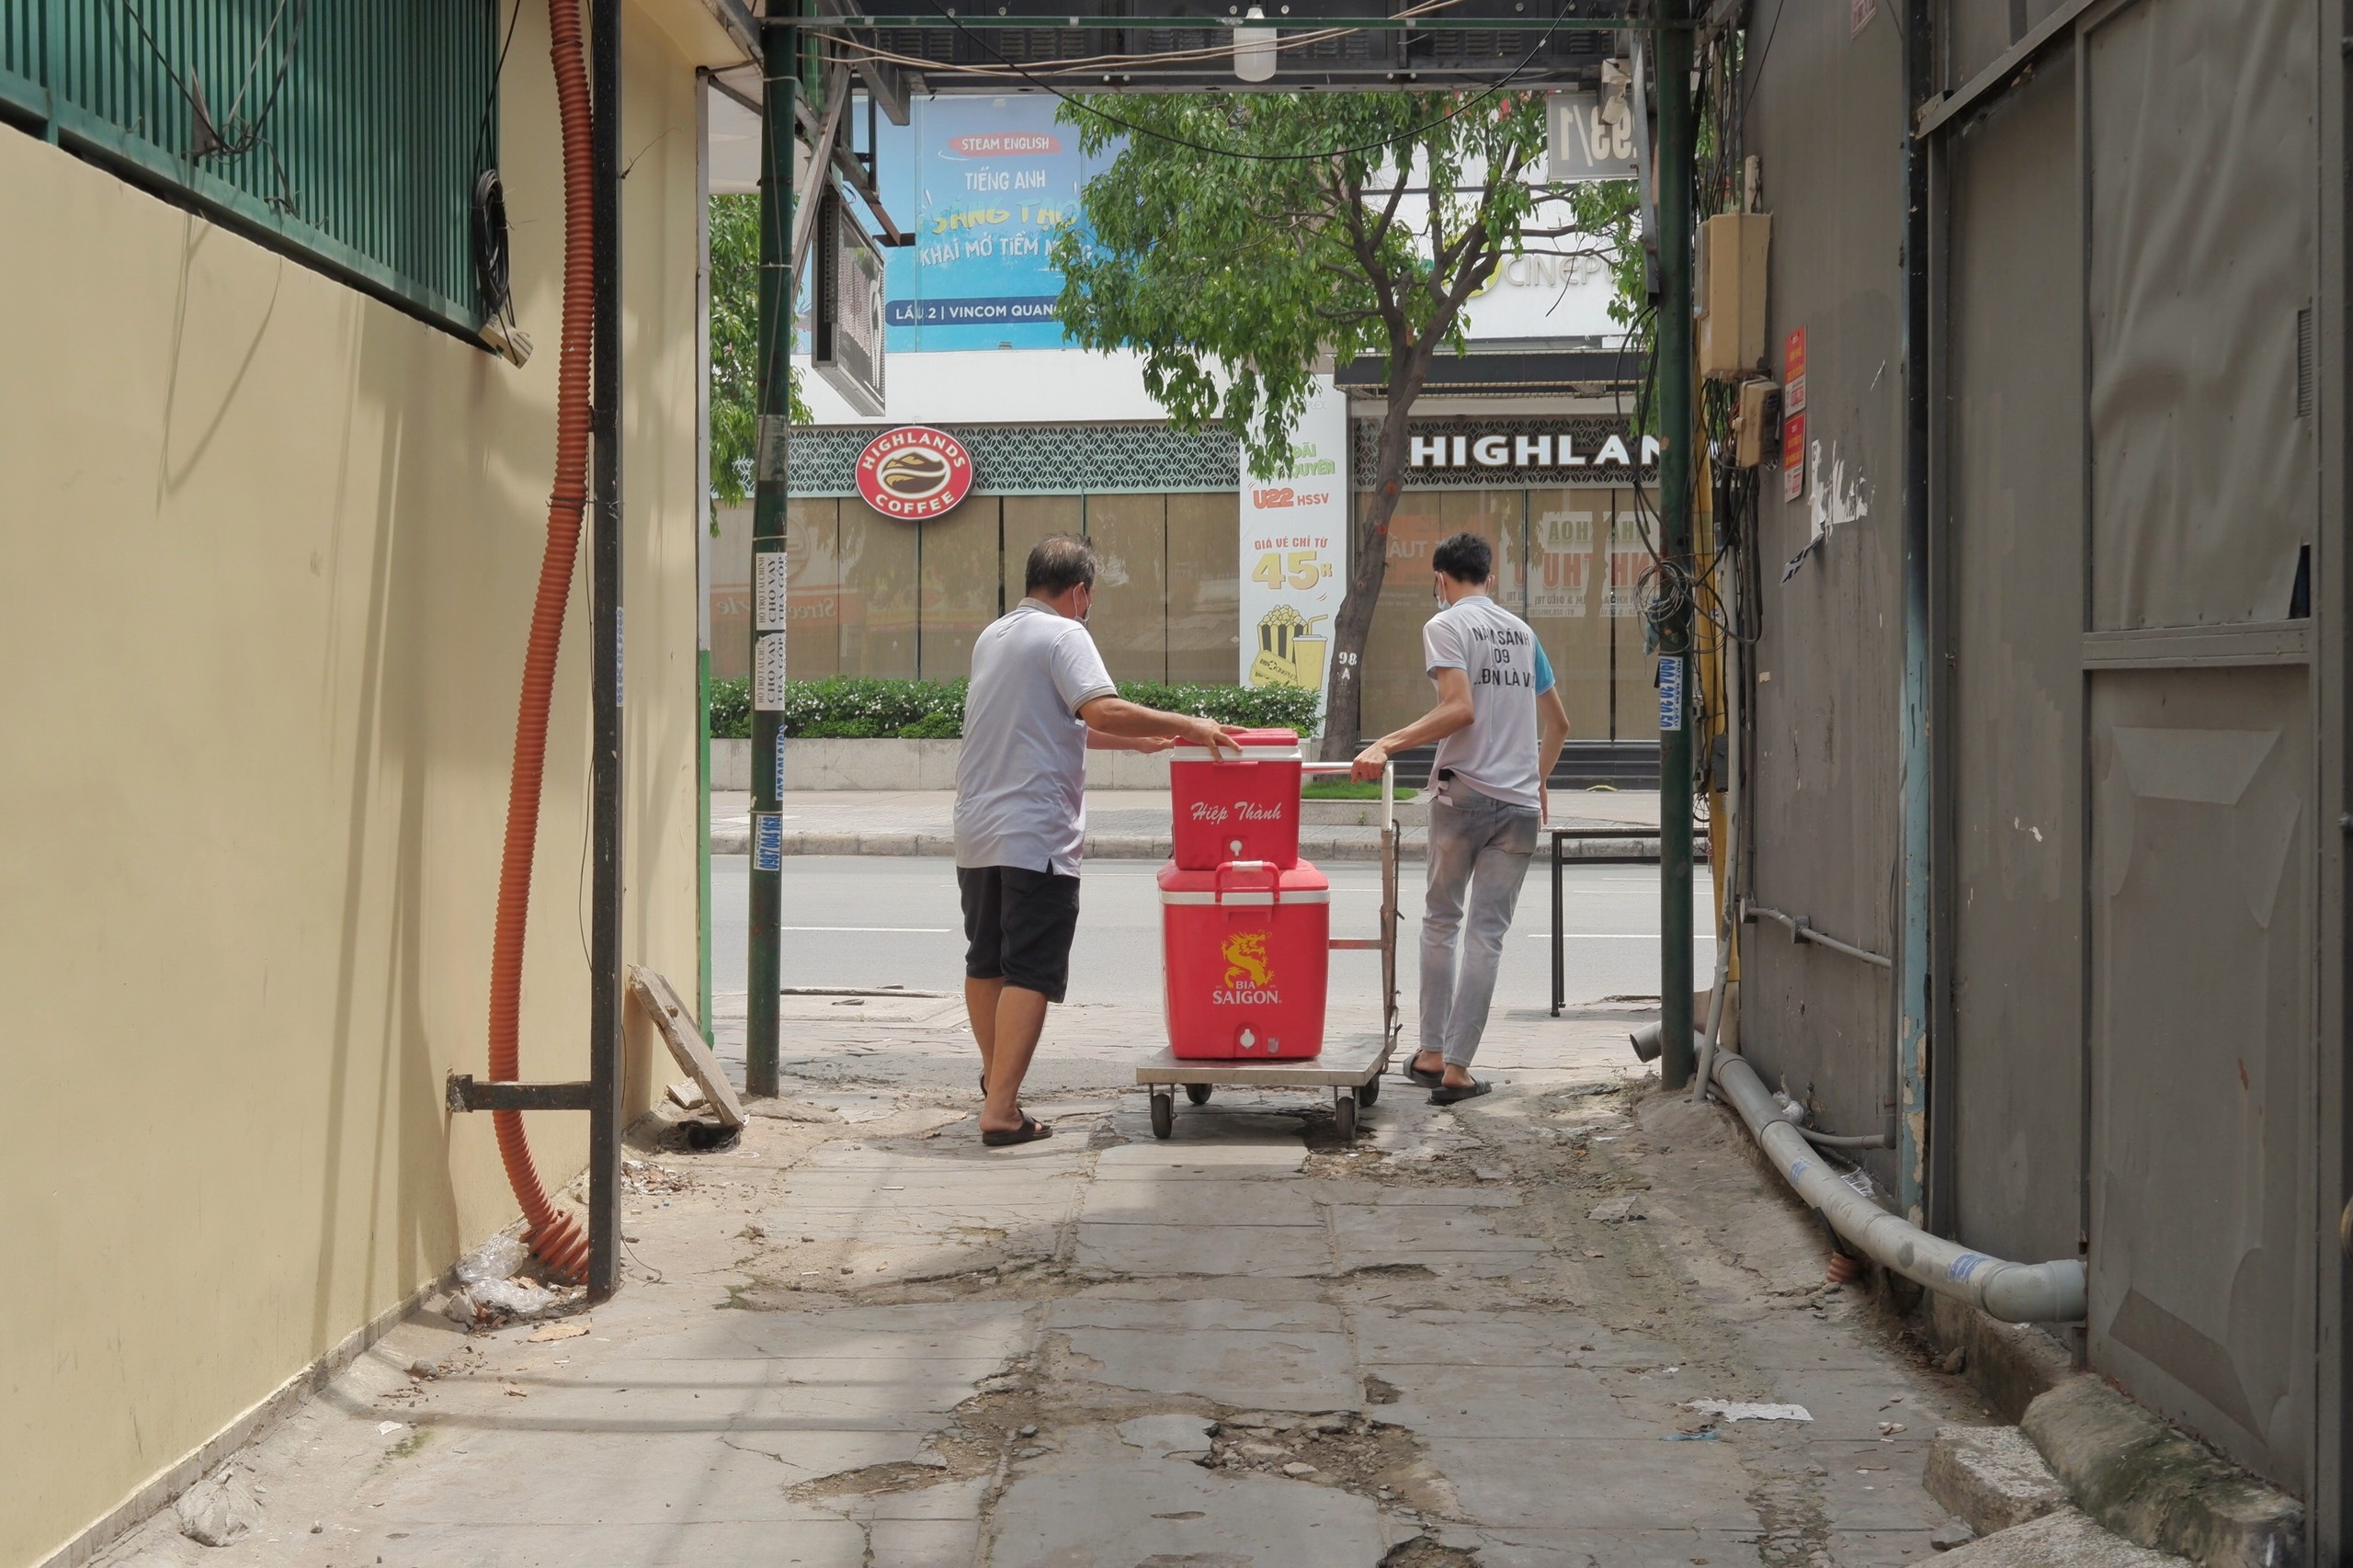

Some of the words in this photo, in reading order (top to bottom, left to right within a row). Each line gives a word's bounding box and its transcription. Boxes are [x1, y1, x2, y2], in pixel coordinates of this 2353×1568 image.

[961, 138, 1000, 152] STEAM
[1004, 137, 1050, 151] ENGLISH
[964, 166, 1010, 191] TIẾNG
[1014, 169, 1046, 189] ANH
[930, 195, 1011, 234] SÁNG
[1015, 198, 1081, 232] TẠO
[920, 236, 961, 267] KHAI
[965, 232, 993, 258] MỞ
[1000, 228, 1039, 256] TIỀM
[927, 307, 937, 319] 2
[949, 306, 1006, 319] VINCOM
[863, 433, 965, 470] HIGHLANDS
[875, 491, 955, 515] COFFEE
[1253, 487, 1294, 509] U22
[1297, 493, 1329, 506] HSSV
[1254, 537, 1273, 551] GIÁ
[1276, 536, 1289, 548] VÉ
[1292, 535, 1311, 548] CHỈ
[767, 557, 776, 585] VAY
[767, 636, 776, 665] VAY
[1338, 652, 1358, 665] 98
[1494, 648, 1510, 664] 09
[1342, 667, 1351, 680] A
[1505, 667, 1520, 686] LÀ
[1660, 658, 1676, 684] 0904
[767, 670, 776, 703] CHO
[1660, 686, 1675, 699] 30
[1660, 700, 1674, 713] 30
[1660, 714, 1675, 728] 50
[1190, 801, 1229, 825] Hiệp
[1233, 801, 1282, 821] Thành
[762, 816, 781, 831] 168
[760, 832, 780, 848] 004
[758, 848, 779, 869] 0987
[1235, 980, 1256, 990] BIA
[1212, 990, 1279, 1005] SAIGON
